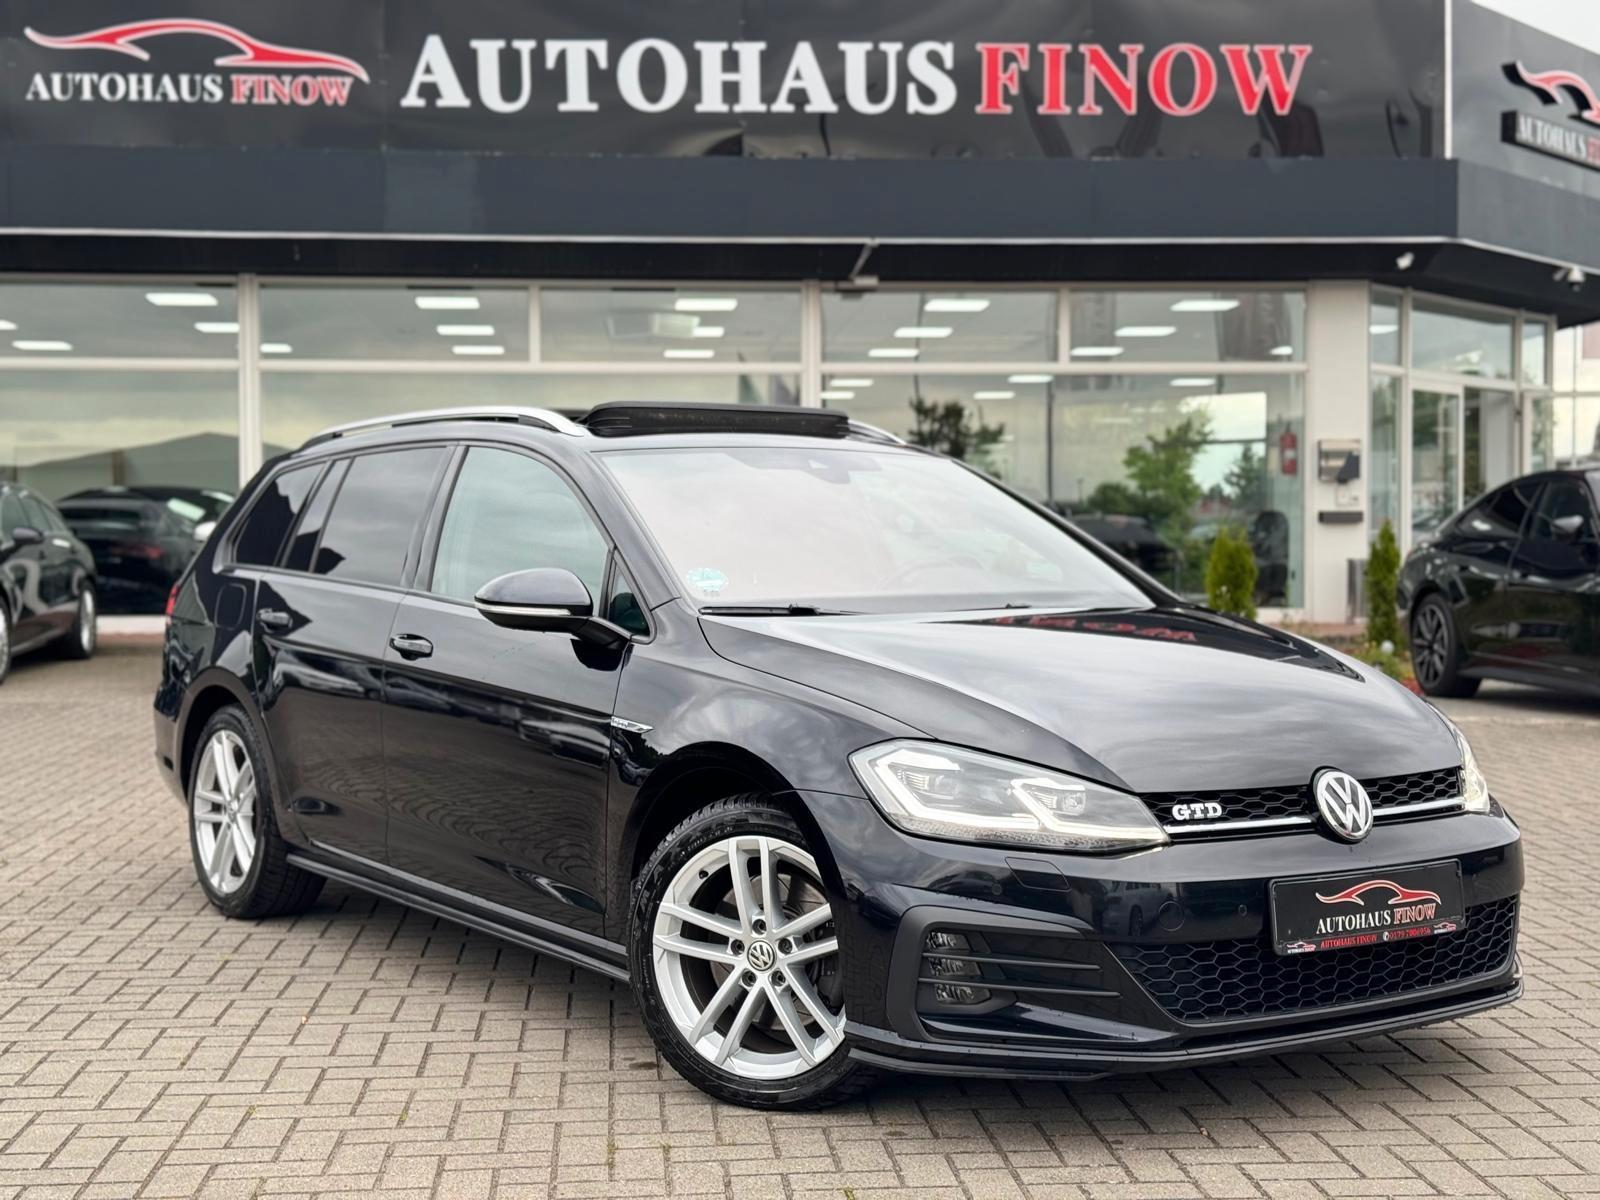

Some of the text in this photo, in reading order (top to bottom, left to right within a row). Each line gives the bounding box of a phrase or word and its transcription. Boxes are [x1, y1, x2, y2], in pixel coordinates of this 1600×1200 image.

[25, 71, 354, 106] AUTOHAUS FINOW
[400, 34, 1312, 117] AUTOHAUS FINOW
[1516, 113, 1587, 160] AUTOHAUS
[1171, 802, 1223, 822] GTD
[1316, 903, 1436, 935] AUTOHAUS FINOW
[1320, 933, 1377, 949] AUTOHAUS FINOW
